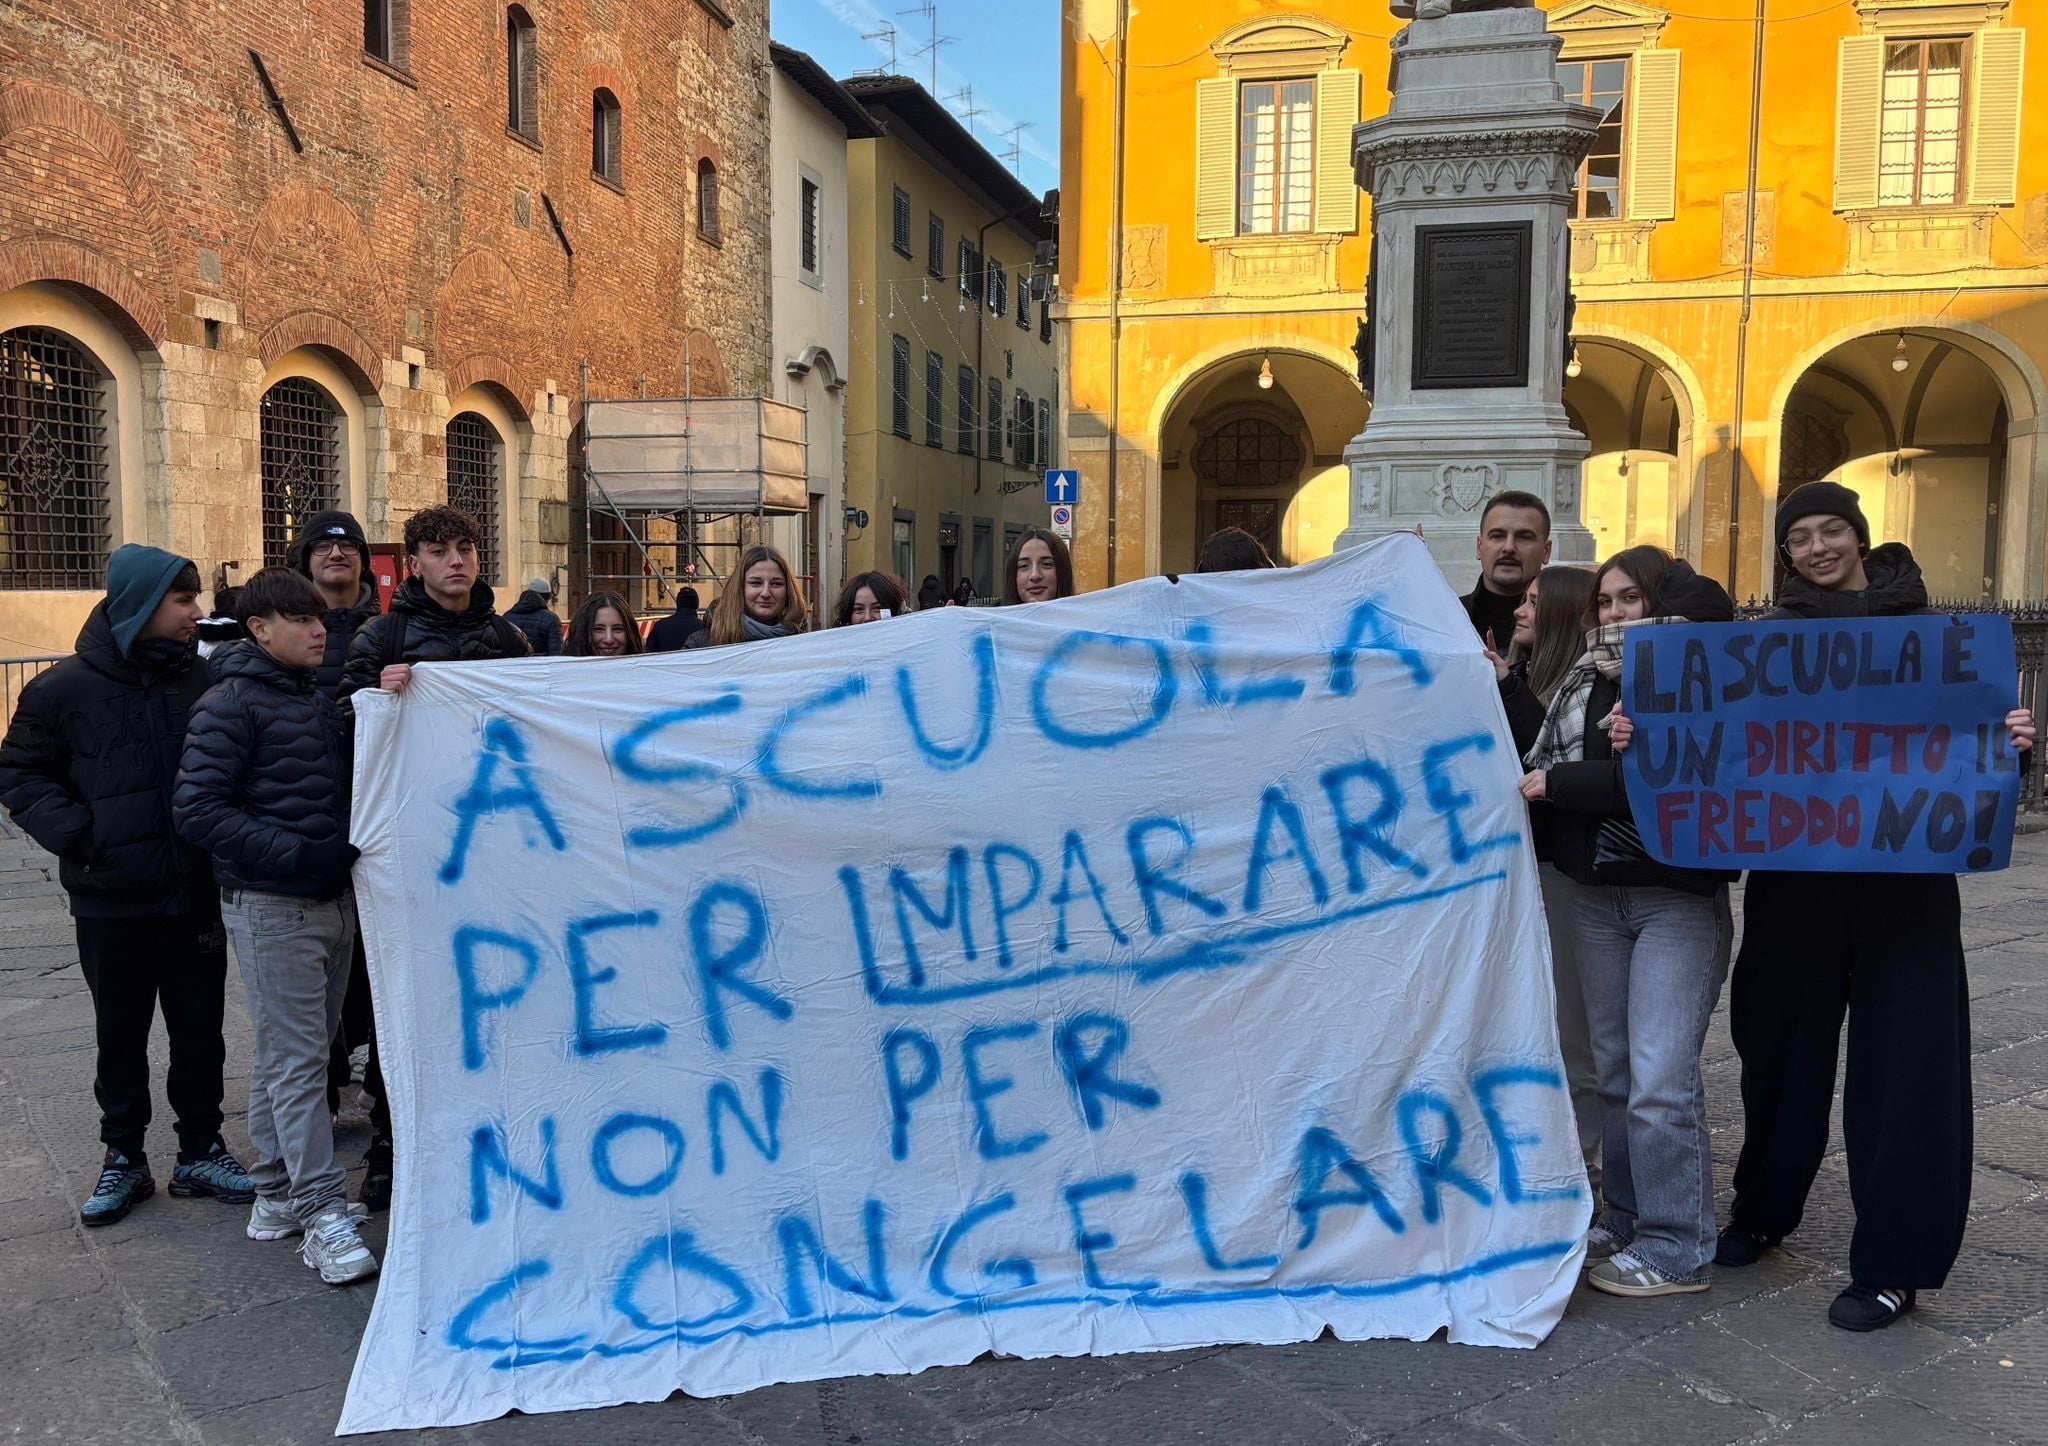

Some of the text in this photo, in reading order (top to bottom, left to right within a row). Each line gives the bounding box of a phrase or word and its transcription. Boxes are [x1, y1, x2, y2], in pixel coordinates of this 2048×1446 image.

[436, 596, 1436, 888] A SCUOLA
[1634, 615, 1979, 713] LA SCUOLA È
[1636, 721, 1725, 788] UN
[1975, 722, 2017, 774] IL
[450, 728, 1522, 1073] PER IMPARARE
[1656, 787, 2000, 871] FREDDO NO!
[443, 1063, 1583, 1352] CONGELARE
[468, 1010, 1162, 1228] NON PER
